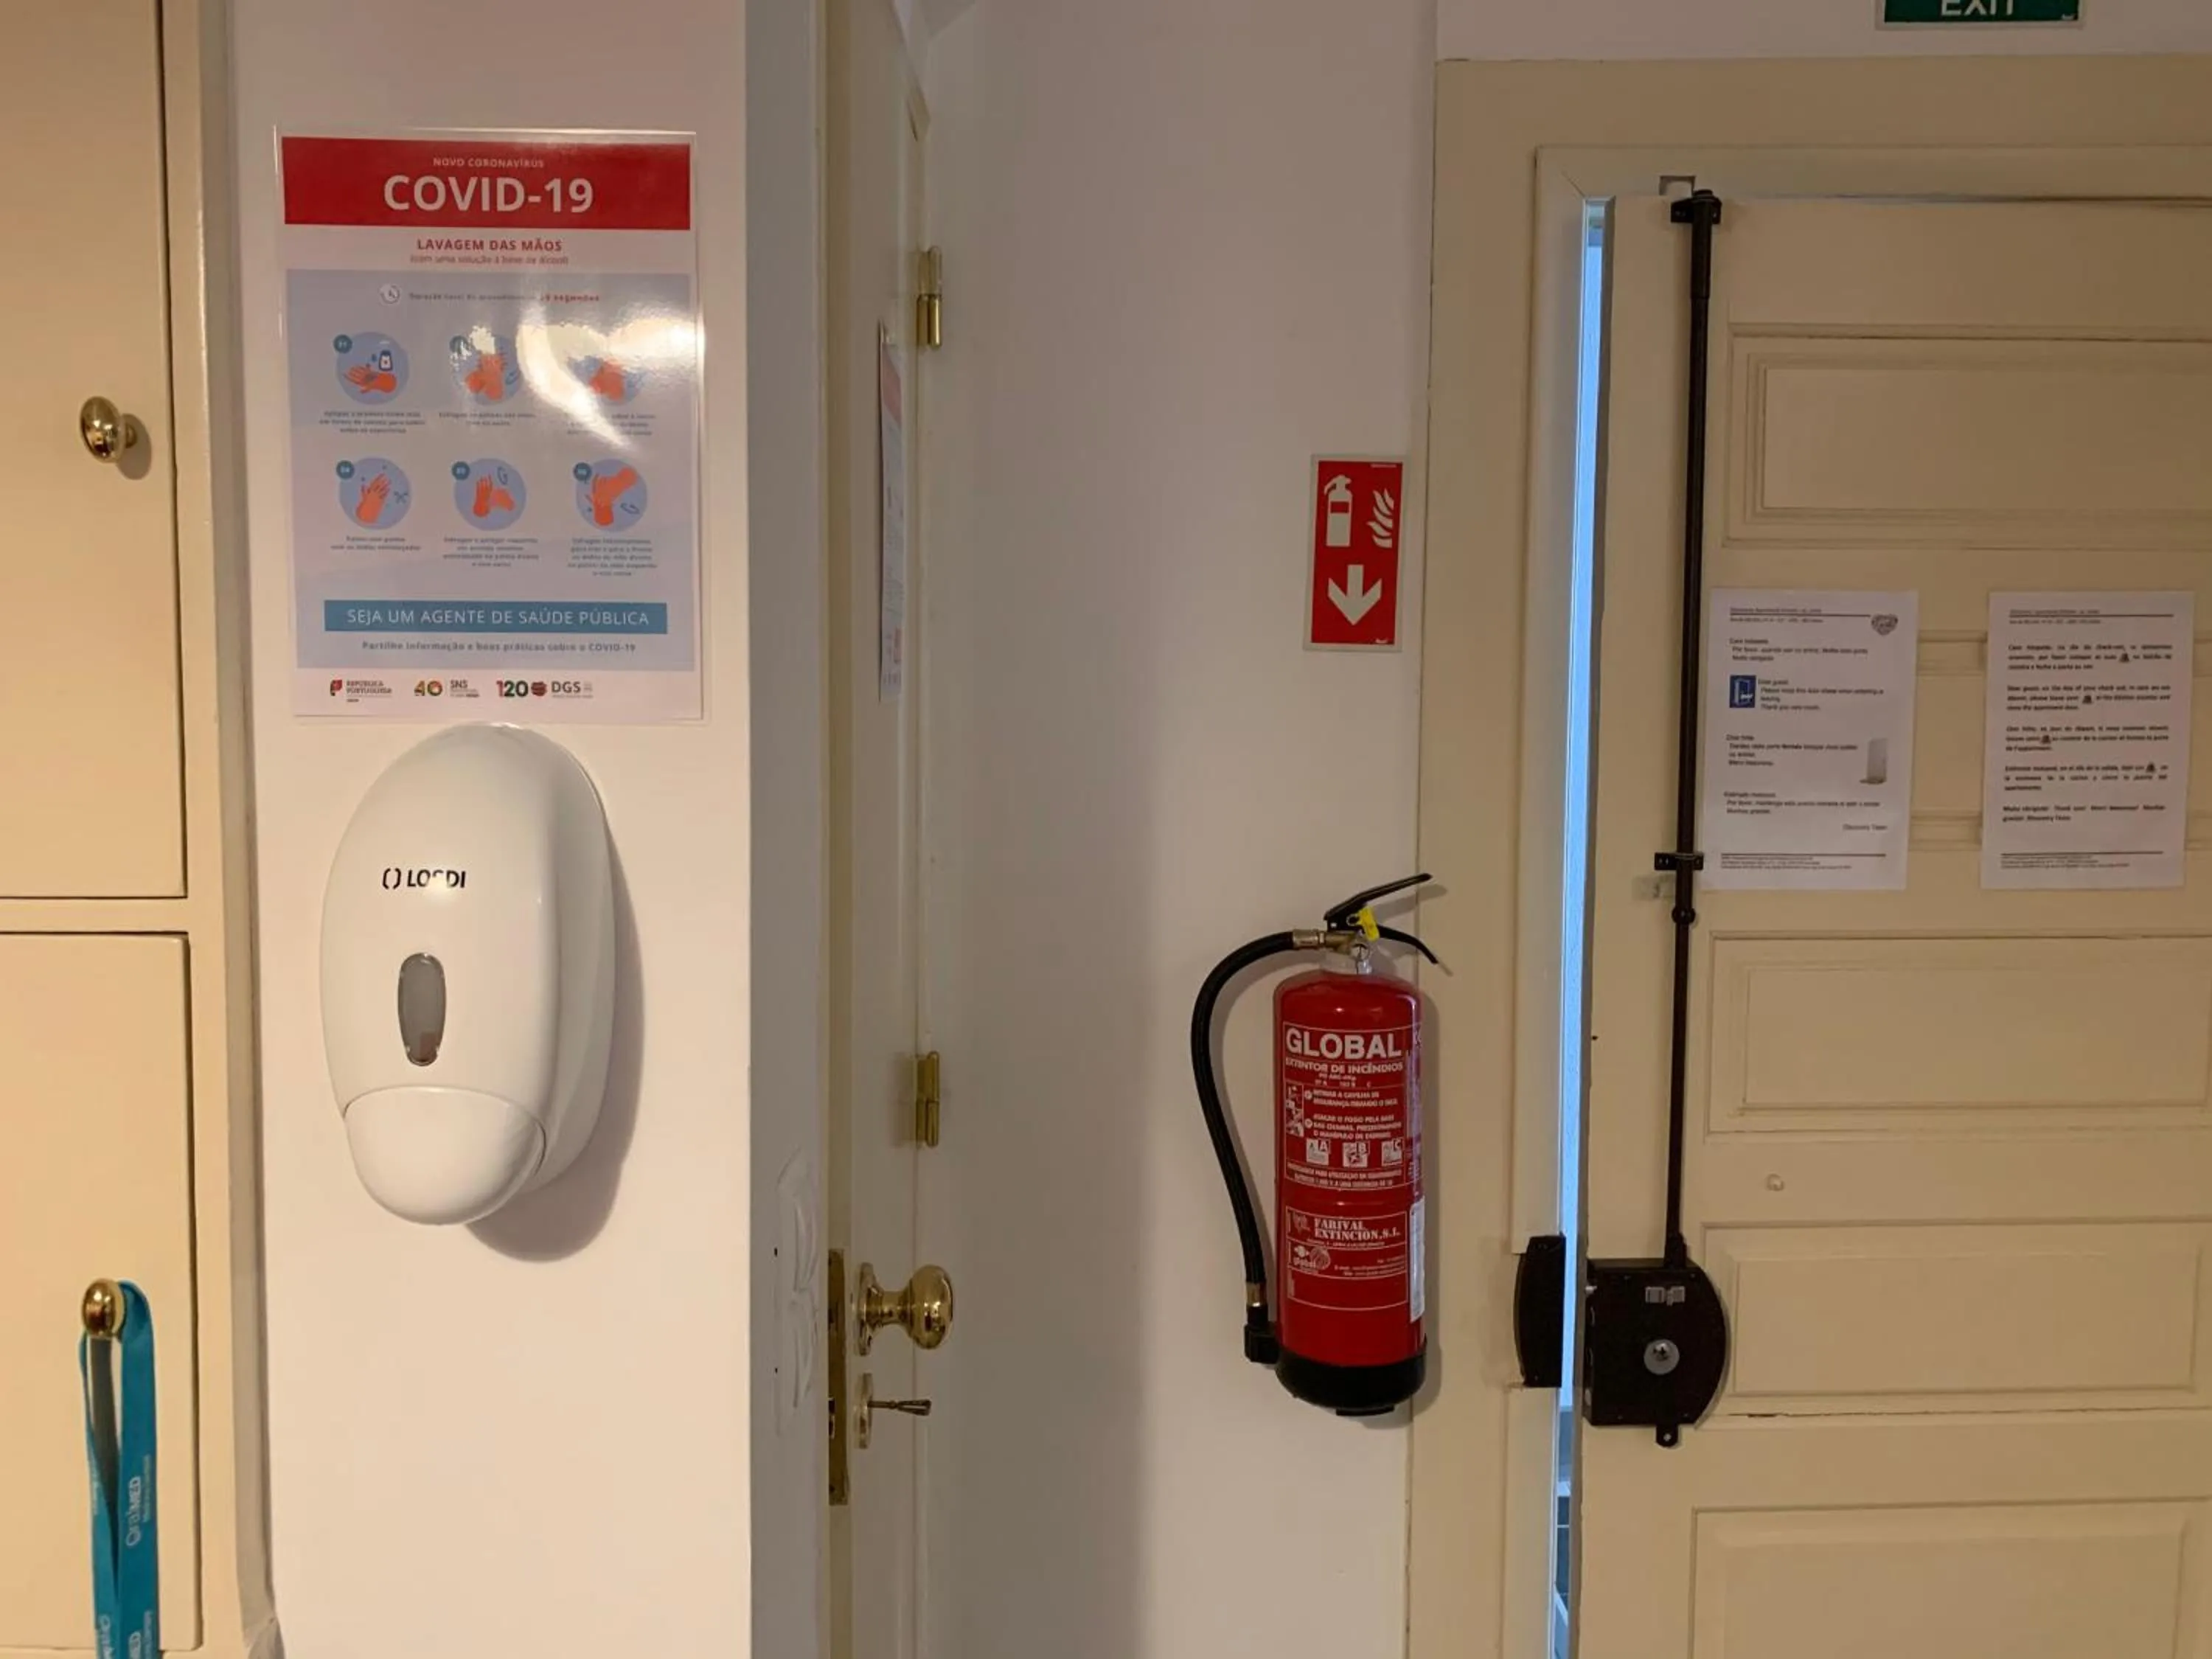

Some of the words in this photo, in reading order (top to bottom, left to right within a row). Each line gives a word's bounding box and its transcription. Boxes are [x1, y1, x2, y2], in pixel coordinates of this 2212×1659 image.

[433, 157, 465, 167] NOVO
[383, 175, 594, 213] COVID-19
[417, 238, 484, 251] LAVAGEM
[490, 240, 517, 251] DAS
[521, 237, 563, 252] MÃOS
[347, 608, 383, 625] SEJA
[389, 609, 414, 624] UM
[420, 610, 484, 625] AGENTE
[492, 610, 513, 625] DE
[518, 607, 573, 625] SAÚDE
[579, 608, 650, 626] PÚBLICA
[551, 680, 582, 694] DGS
[1287, 1028, 1402, 1060] GLOBAL
[1285, 1057, 1328, 1072] EXTINTOR
[1331, 1064, 1345, 1074] DE
[1348, 1061, 1403, 1074] INCÊNDIOS
[1319, 1141, 1328, 1151] A
